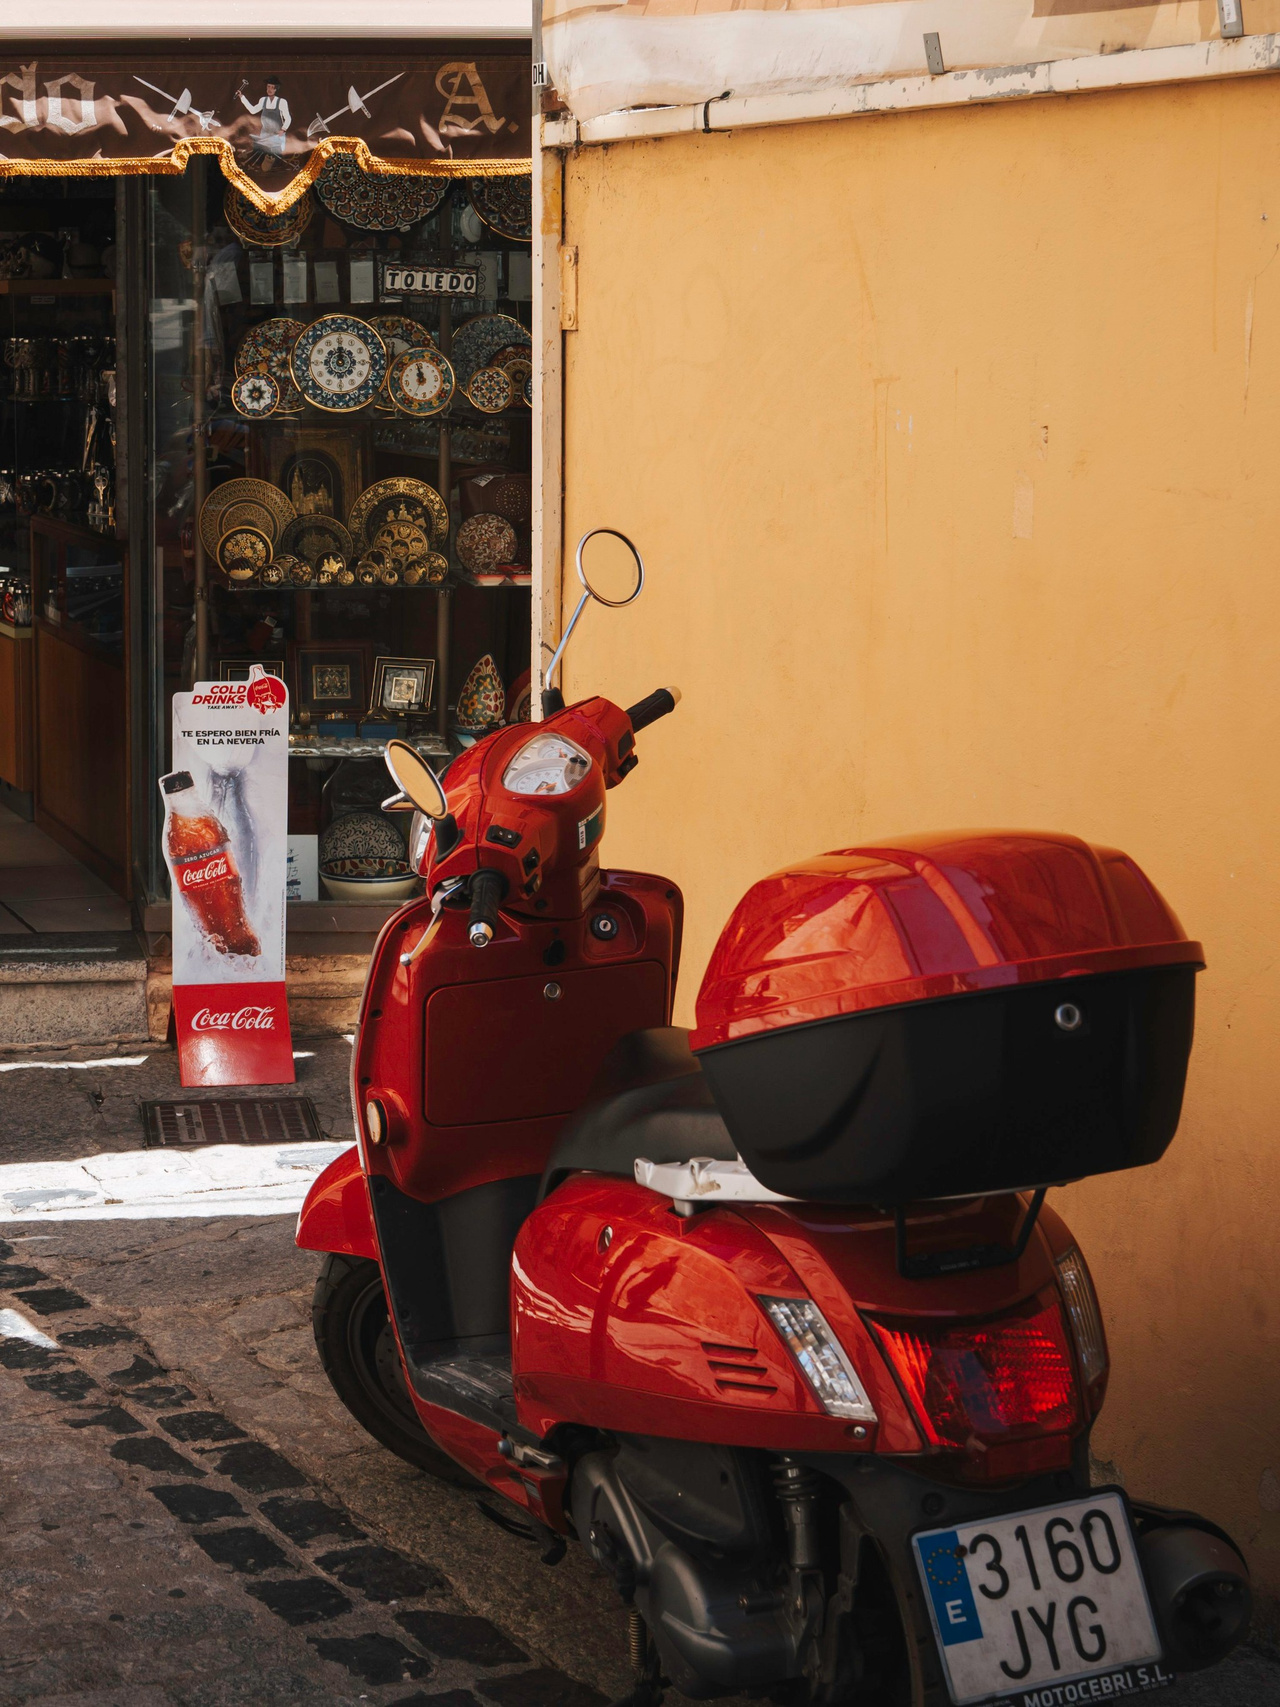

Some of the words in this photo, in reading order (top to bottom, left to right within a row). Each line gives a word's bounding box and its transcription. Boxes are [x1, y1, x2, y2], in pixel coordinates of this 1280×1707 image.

[388, 271, 475, 292] TOLEDO
[192, 694, 247, 705] DRINKS
[210, 685, 247, 695] COLD
[235, 729, 257, 737] BIEN
[259, 728, 280, 737] FRÍA
[183, 857, 227, 886] Coca-Cola
[191, 1006, 276, 1031] Coca-Cola
[969, 1509, 1121, 1600] 3160
[945, 1599, 967, 1624] E
[1000, 1595, 1107, 1680] JYG
[1023, 1671, 1133, 1707] MOTOCEBRI
[1136, 1665, 1174, 1685] S.L.
